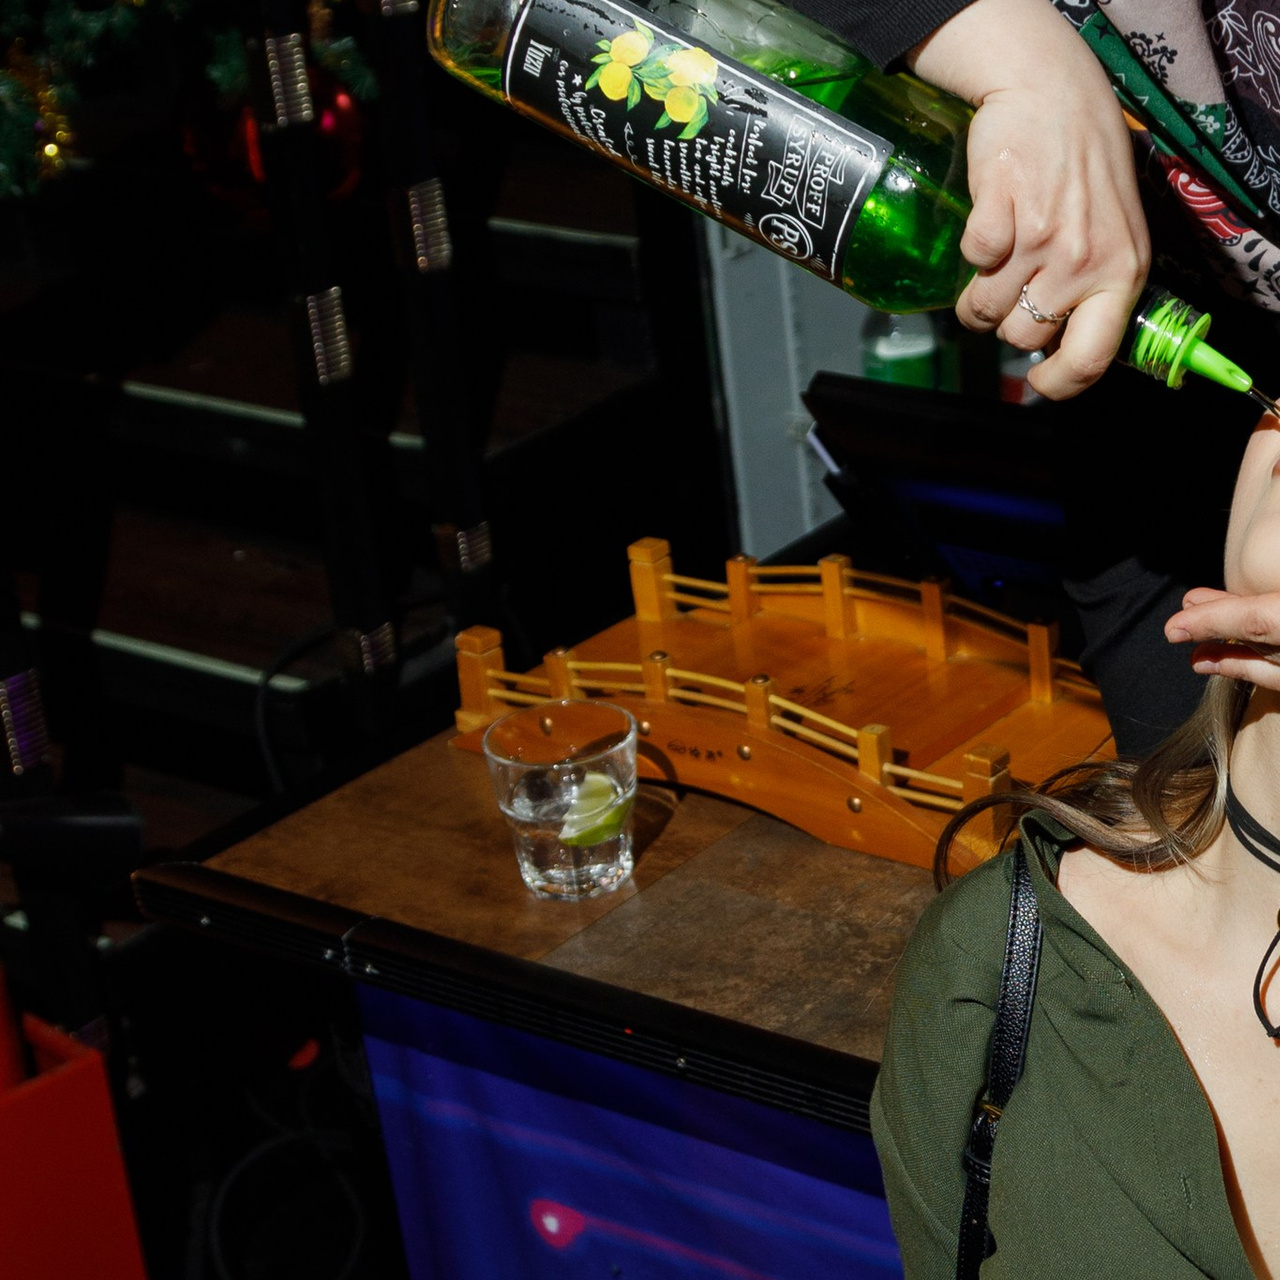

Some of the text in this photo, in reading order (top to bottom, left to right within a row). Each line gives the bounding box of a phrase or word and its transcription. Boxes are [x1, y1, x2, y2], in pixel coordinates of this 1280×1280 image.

[570, 91, 587, 104] by
[591, 108, 622, 157] Created
[695, 138, 708, 159] tea
[646, 138, 660, 169] sweet
[679, 142, 692, 193] smoothies
[694, 163, 706, 185] and
[705, 136, 725, 177] bright
[720, 129, 737, 187] cocktails
[780, 127, 807, 195] SYRUP
[741, 168, 758, 194] for:
[805, 150, 836, 217] PROFF
